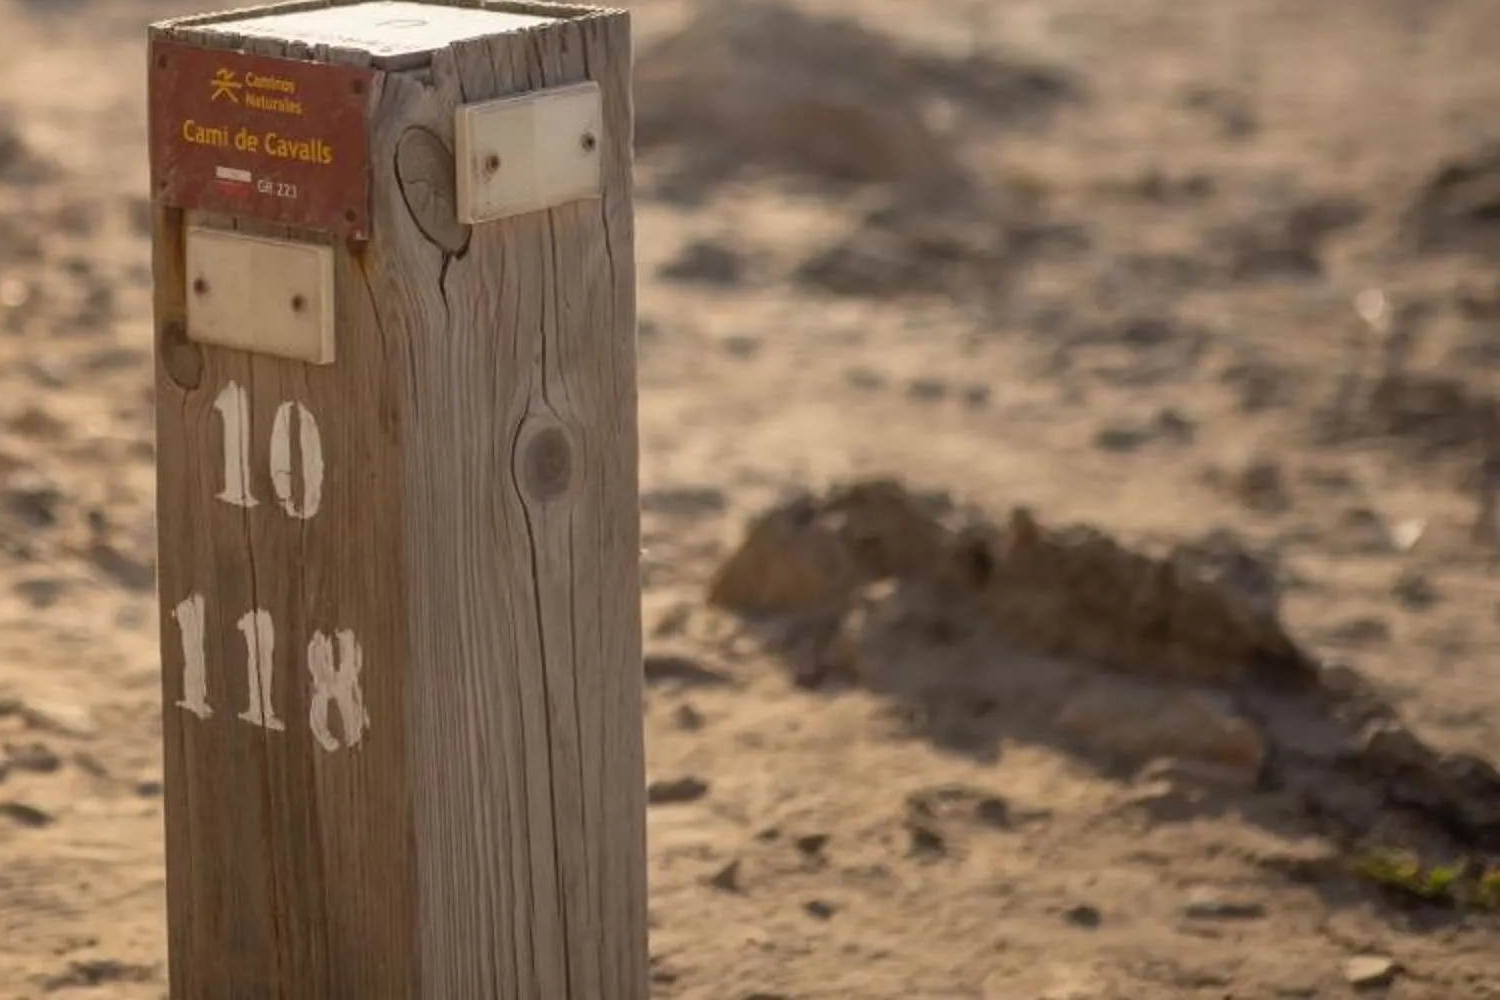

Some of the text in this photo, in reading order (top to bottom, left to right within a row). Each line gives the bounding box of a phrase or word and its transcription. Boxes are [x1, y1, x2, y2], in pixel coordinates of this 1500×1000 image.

[245, 95, 302, 115] Naturales
[234, 127, 259, 152] de
[264, 132, 333, 164] Cavalls
[257, 179, 273, 196] GR
[213, 380, 325, 520] 10
[171, 592, 370, 753] 118
